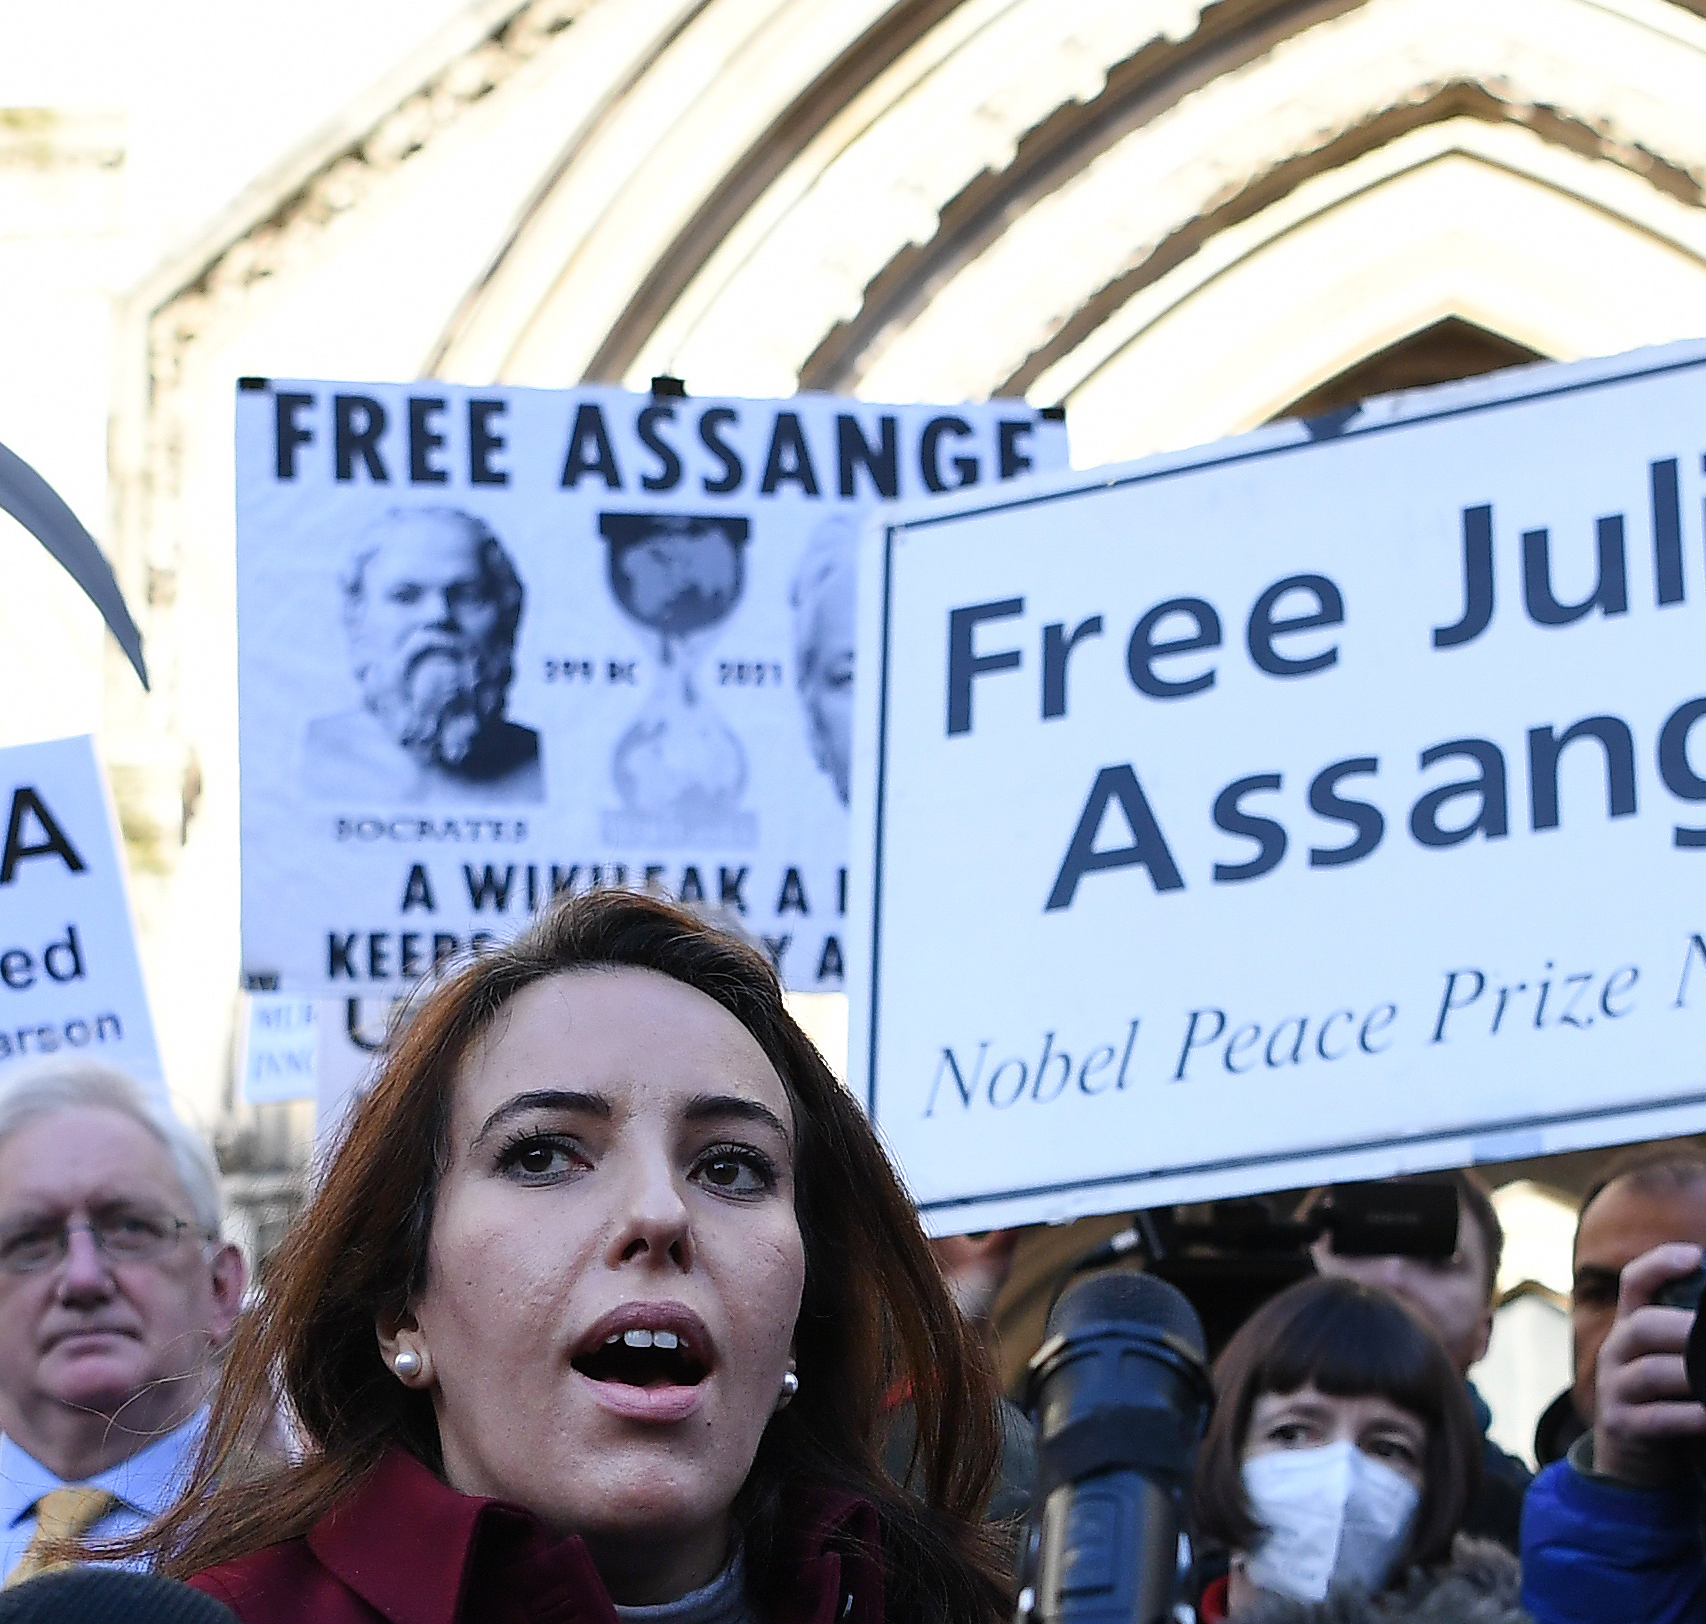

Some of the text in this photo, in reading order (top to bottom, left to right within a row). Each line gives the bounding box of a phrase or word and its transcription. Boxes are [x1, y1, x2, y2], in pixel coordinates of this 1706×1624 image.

[272, 392, 1037, 501] FREE ASSANGE
[945, 573, 1347, 739] Free
[402, 863, 436, 915] A
[776, 865, 812, 917] A
[922, 1018, 1140, 1119] Nobel
[1172, 1004, 1398, 1083] Peace
[1429, 957, 1641, 1044] Prize
